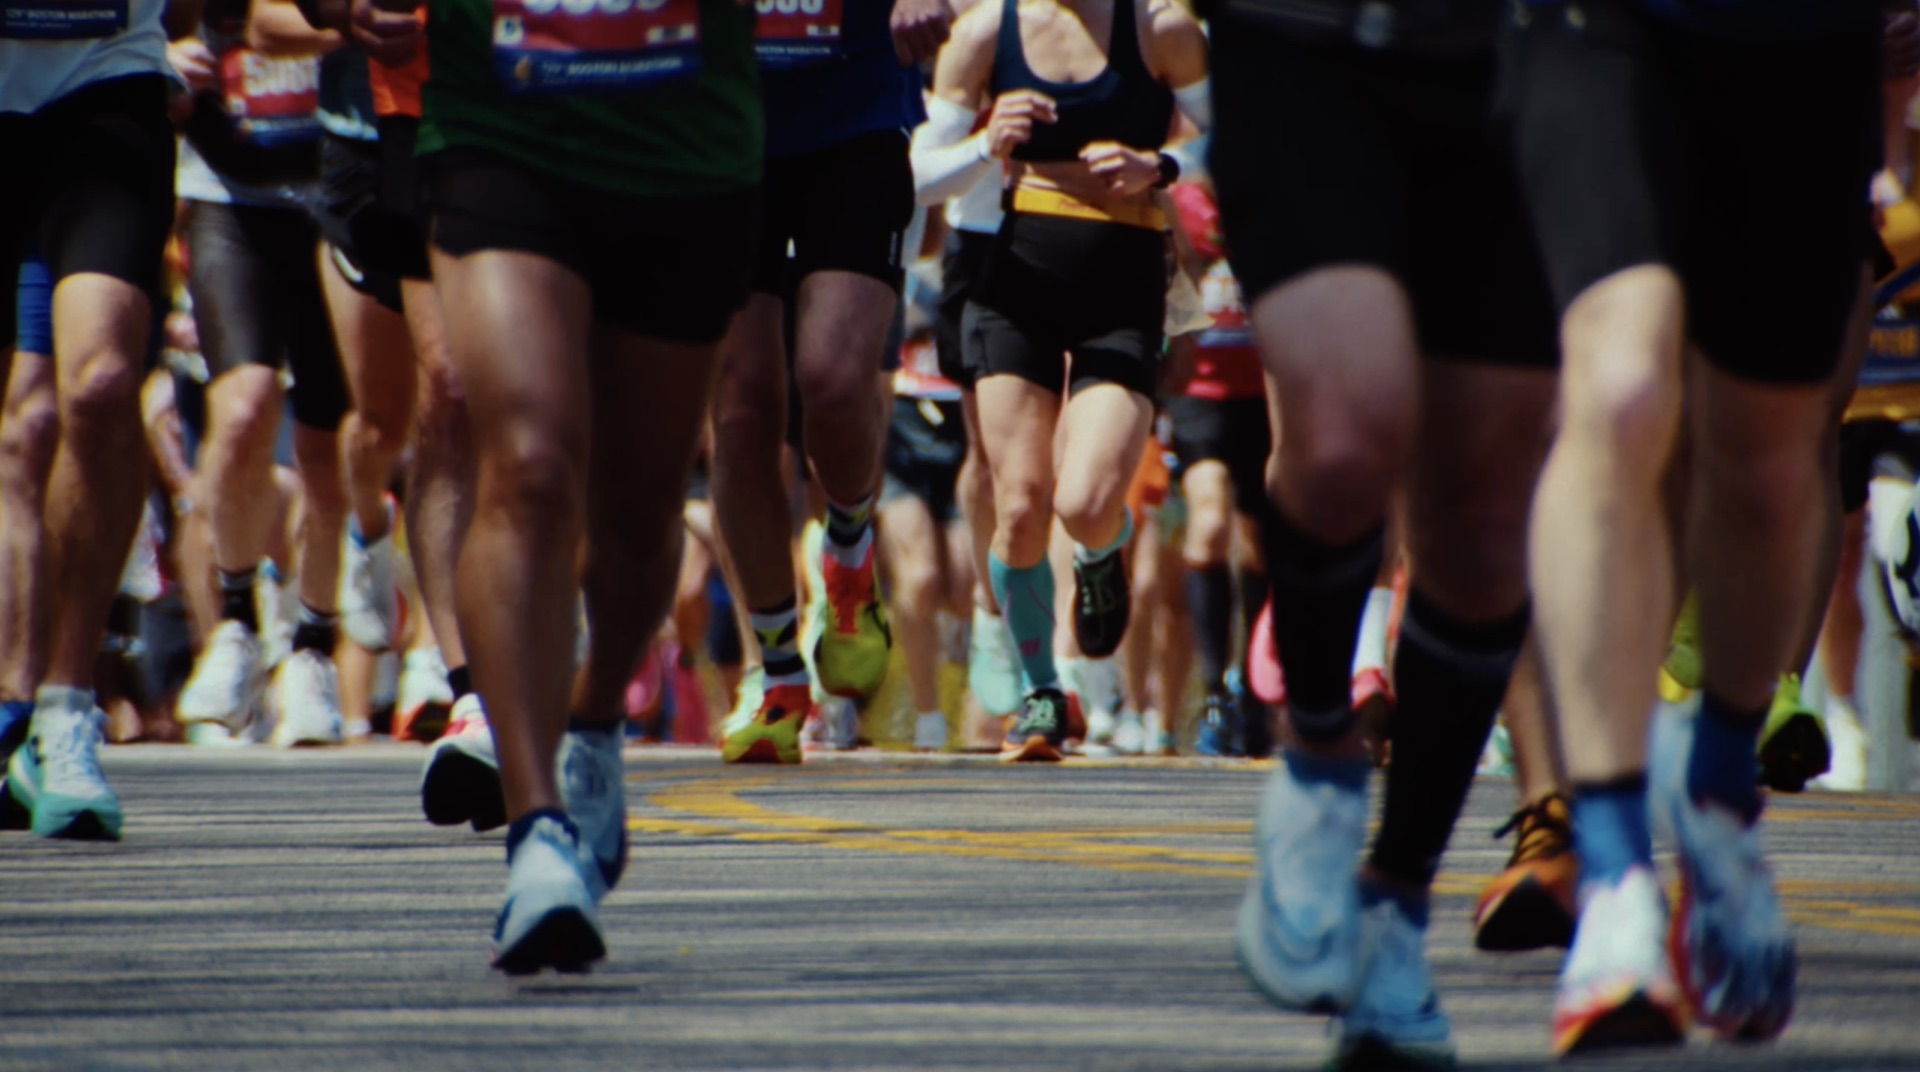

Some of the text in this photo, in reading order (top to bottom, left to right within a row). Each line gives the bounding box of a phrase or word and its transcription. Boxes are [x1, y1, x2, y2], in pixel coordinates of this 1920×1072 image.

[27, 9, 66, 20] BOSTON
[67, 10, 117, 20] MARATHON
[566, 60, 618, 76] BOSTON
